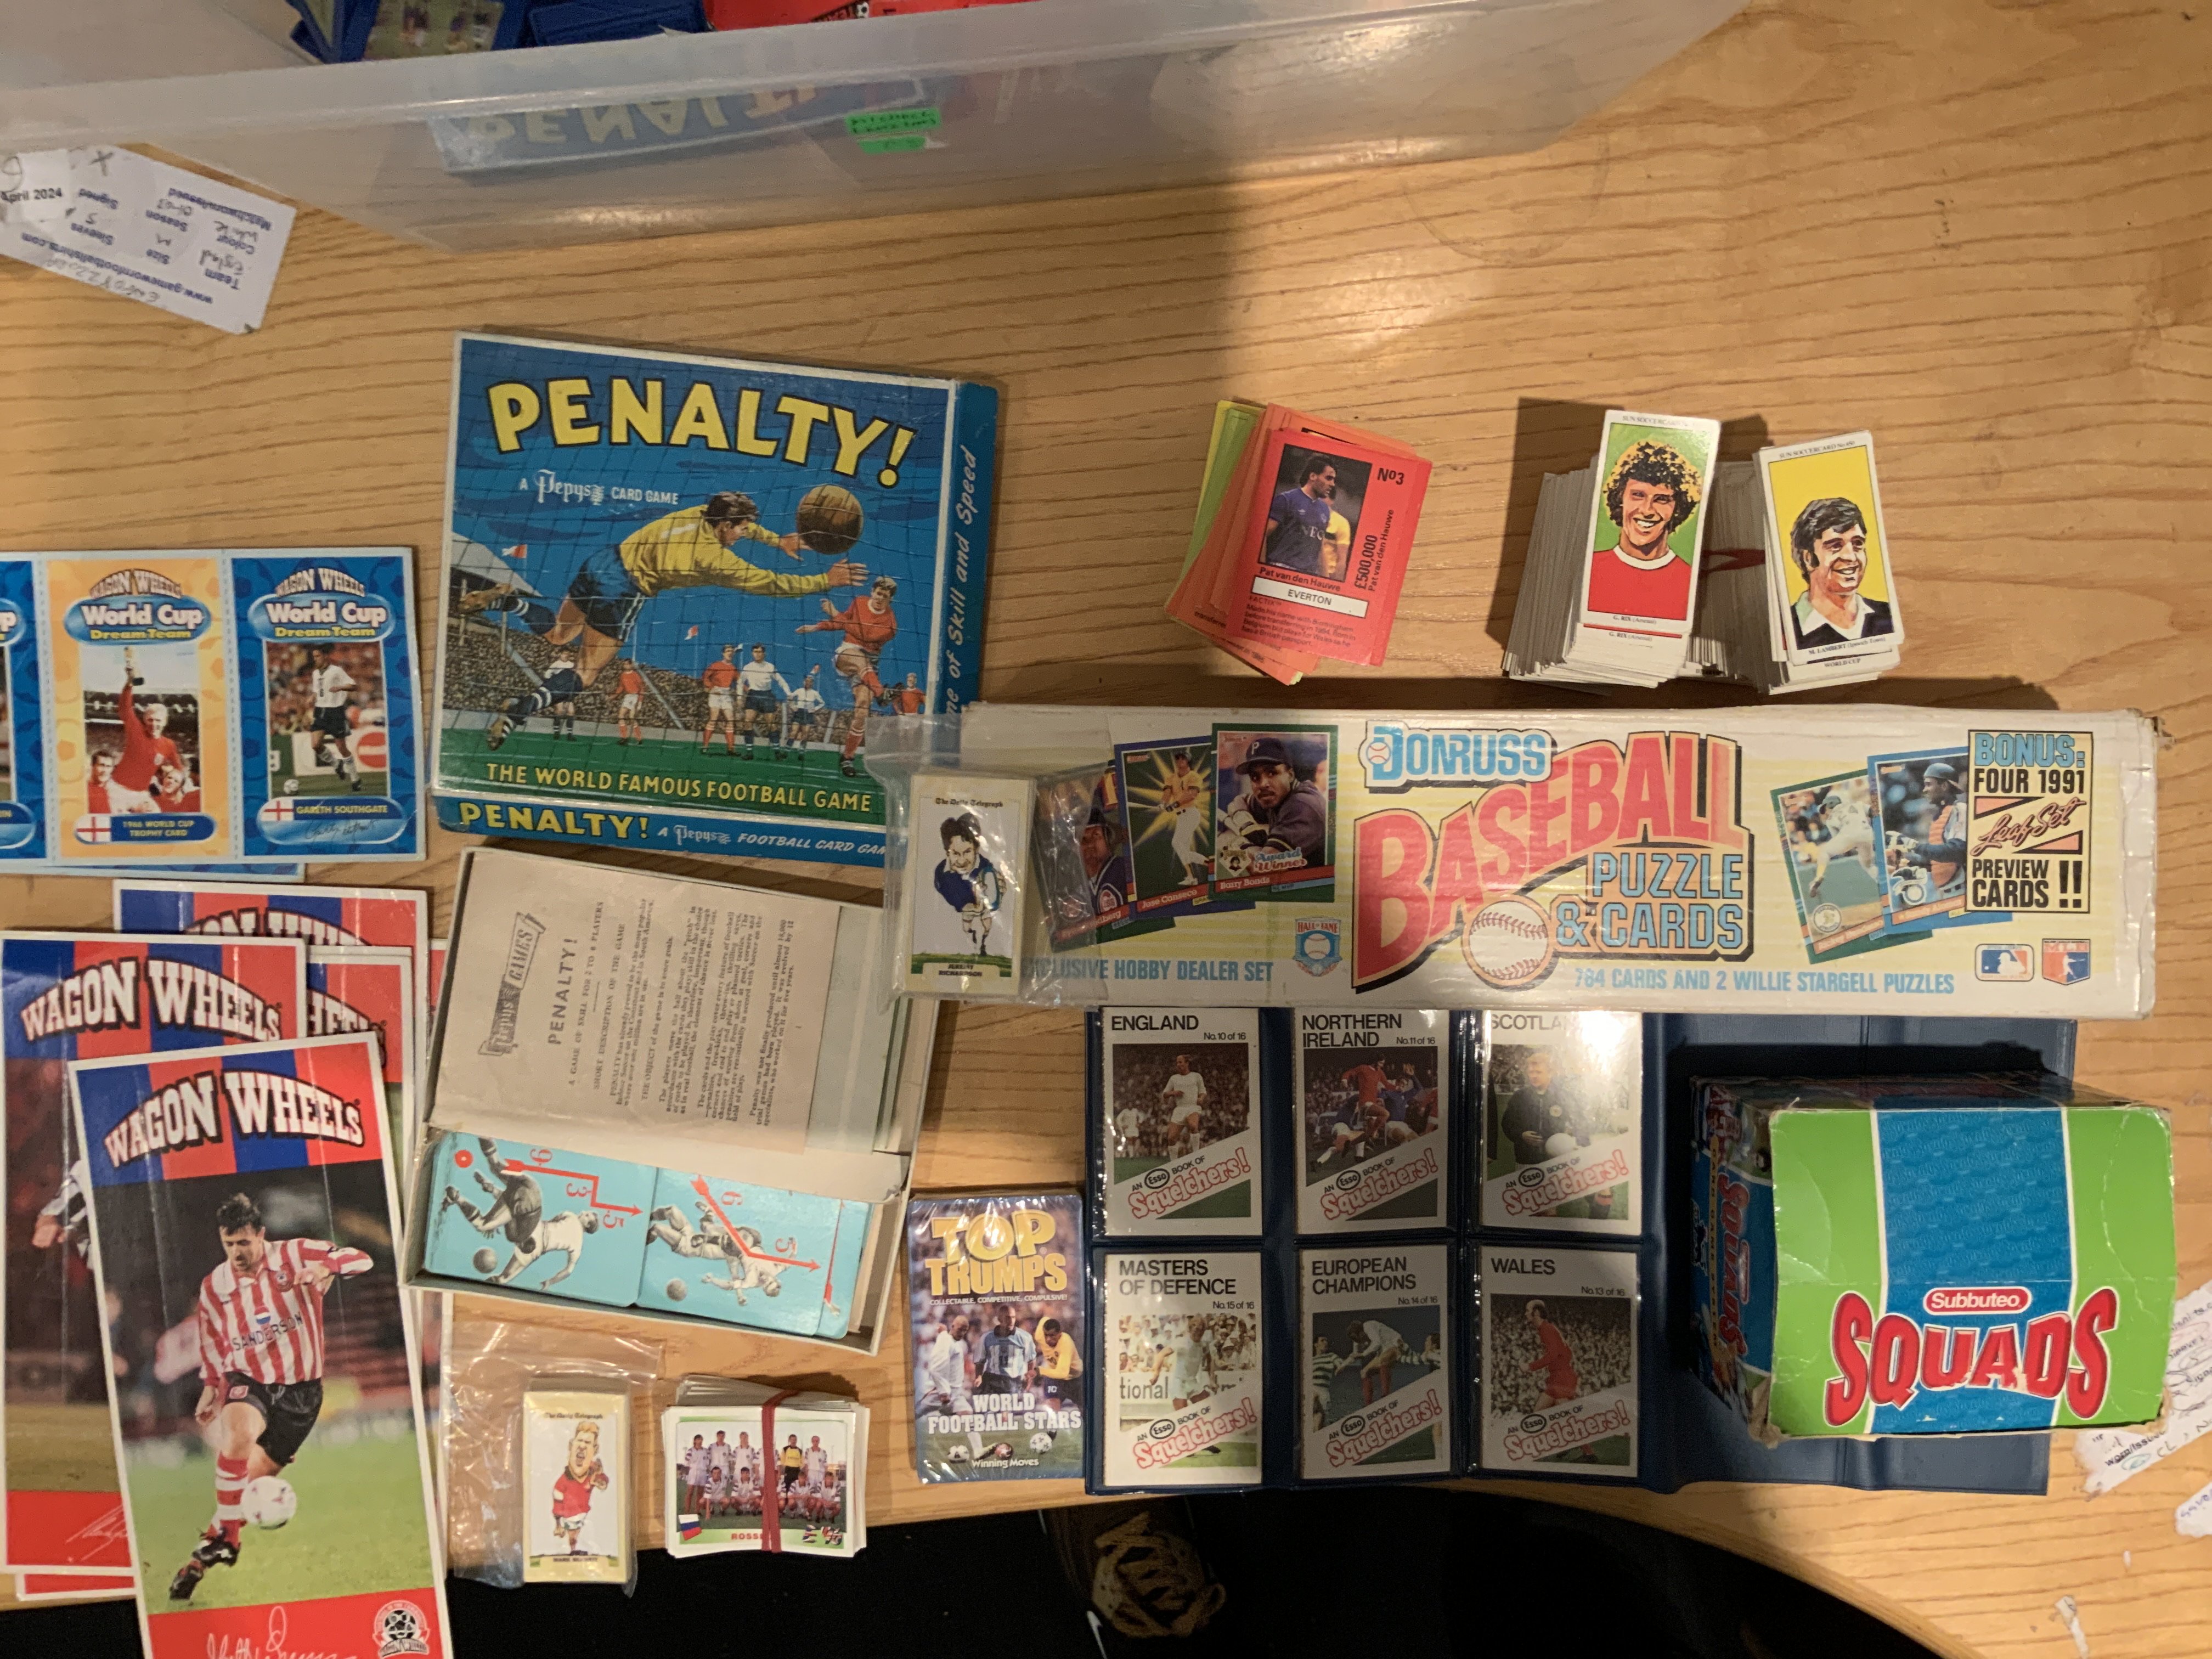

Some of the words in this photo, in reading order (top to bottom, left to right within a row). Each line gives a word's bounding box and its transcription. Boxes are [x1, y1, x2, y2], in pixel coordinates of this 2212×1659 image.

[34, 188, 62, 200] 2024
[78, 188, 119, 210] Signed
[146, 210, 188, 233] Season
[71, 222, 114, 246] Sleeves
[217, 234, 255, 255] Colour
[145, 248, 170, 265] Size
[203, 268, 241, 290] Team
[487, 376, 917, 489] PENALTY!
[519, 478, 528, 491] A
[534, 469, 591, 504] Pepys
[611, 487, 642, 501] CARD
[645, 490, 679, 505] GAME
[956, 444, 978, 526] Speed
[1301, 524, 1323, 540] NEC
[1380, 509, 1394, 540] Hauwe
[956, 532, 970, 583] and
[1353, 534, 1379, 589] £500,000
[1376, 541, 1386, 558] den
[1259, 567, 1275, 577] Pat
[1276, 572, 1291, 580] van
[1292, 574, 1308, 584] den
[1310, 578, 1341, 591] Hauwe
[1373, 559, 1382, 575] van
[1368, 577, 1378, 591] Pat
[1288, 589, 1331, 605] EVERTON
[81, 602, 153, 625] World
[157, 604, 203, 630] Cup
[266, 601, 337, 623] World
[342, 602, 386, 628] Cup
[948, 587, 966, 647] Skill
[91, 630, 146, 639] Dream
[147, 629, 191, 639] Team
[275, 627, 331, 637] Dream
[331, 626, 376, 636] Team
[1817, 644, 1846, 653] LAMBERT
[946, 649, 961, 679] of
[1371, 726, 1548, 781] DONRUSS
[1975, 733, 2085, 767] BONUS:
[487, 764, 527, 785] THE
[534, 768, 613, 790] WORLD
[618, 773, 702, 798] FAMOUS
[706, 780, 808, 807] FOOTBALL
[813, 788, 872, 812] GAME
[1974, 770, 2028, 793] FOUR
[2039, 770, 2085, 794] 1991
[296, 805, 332, 815] GARETH
[334, 805, 388, 814] SOUTHGATE
[129, 829, 162, 837] TROPHY
[164, 828, 188, 837] CARD
[145, 820, 176, 828] WORLD
[177, 819, 195, 828] CUP
[459, 802, 649, 839] PENALTY!
[658, 827, 668, 839] A
[673, 824, 718, 847] Pepys
[737, 832, 812, 849] FOOTBALL
[815, 839, 855, 853] CARD
[857, 844, 887, 855] GAM
[1971, 814, 2032, 855] Leaf
[2033, 797, 2086, 834] Set
[1255, 851, 1302, 864] Award
[1256, 858, 1307, 872] Winner
[1356, 737, 1745, 981] BASEBALL
[1972, 860, 2049, 879] PREVIEW
[1220, 879, 1243, 890] Barry
[1244, 876, 1270, 887] Bonds
[1593, 852, 1743, 899] PUZZLE
[1142, 899, 1160, 910] Jose
[1162, 889, 1198, 905] Canseco
[1972, 879, 2050, 908] CARDS
[1556, 901, 1591, 947] &
[1600, 901, 1743, 949] CARDS
[1114, 960, 1171, 980] HOBBY
[1177, 961, 1239, 981] DEALER
[1244, 962, 1274, 982] SET
[1575, 968, 1605, 988] 784
[1612, 969, 1667, 989] CARDS
[1673, 970, 1708, 990] AND
[1717, 970, 1726, 990] 2
[1734, 971, 1790, 991] WILLIE
[1797, 972, 1878, 992] STARGELL
[1883, 973, 1955, 994] PUZZLES
[21, 960, 138, 1042] WAGON
[147, 960, 281, 1041] WHEELS
[548, 937, 577, 1045] PENALTY!
[1111, 1015, 1199, 1031] ENGLAND
[1302, 1014, 1402, 1030] NORTHERN
[1491, 1014, 1565, 1030] SCOTLA
[1227, 1032, 1235, 1040] of
[1237, 1032, 1246, 1040] 16
[1303, 1032, 1380, 1048] IRELAND
[105, 1075, 215, 1168] WAGON
[223, 1072, 364, 1147] WHEELS
[1128, 1147, 1251, 1219] Squelchers!
[1132, 1182, 1143, 1192] AN
[1171, 1160, 1194, 1175] BOOK
[1195, 1155, 1206, 1164] OF
[1320, 1147, 1438, 1221] Squelchers!
[1502, 1149, 1629, 1216] Squelchers!
[932, 1210, 1057, 1266] TOP
[925, 1252, 1068, 1296] TRUMPS
[1119, 1260, 1208, 1276] MASTERS
[1312, 1257, 1407, 1276] EUROPEAN
[1491, 1258, 1556, 1275] WALES
[1717, 1172, 1750, 1356] SQUADS
[1119, 1279, 1148, 1295] OF
[1153, 1278, 1236, 1294] DEFENCE
[1312, 1275, 1417, 1295] CHAMPIONS
[929, 1297, 976, 1306] COLLECTABLE,
[977, 1295, 1024, 1304] COMPETITIVE,
[1024, 1294, 1068, 1302] COMPULSIVE!
[1931, 1292, 2021, 1308] Subbuteo
[232, 1311, 303, 1351] SANDERSON
[1825, 1289, 2118, 1426] SQUADS
[1047, 1385, 1058, 1393] 10
[1120, 1376, 1169, 1399] tional
[973, 1392, 1035, 1413] WORLD
[928, 1412, 1018, 1434] FOOTBALL
[1024, 1410, 1082, 1430] STARS
[1326, 1389, 1443, 1468] Squelchers!
[1504, 1399, 1630, 1461] Squelchers!
[1507, 1426, 1519, 1434] AN
[1549, 1409, 1572, 1421] BOOK
[1573, 1404, 1584, 1414] OF
[1132, 1397, 1257, 1469] Squelchers!
[971, 1459, 1009, 1469] Winning
[1009, 1457, 1039, 1468] Moves
